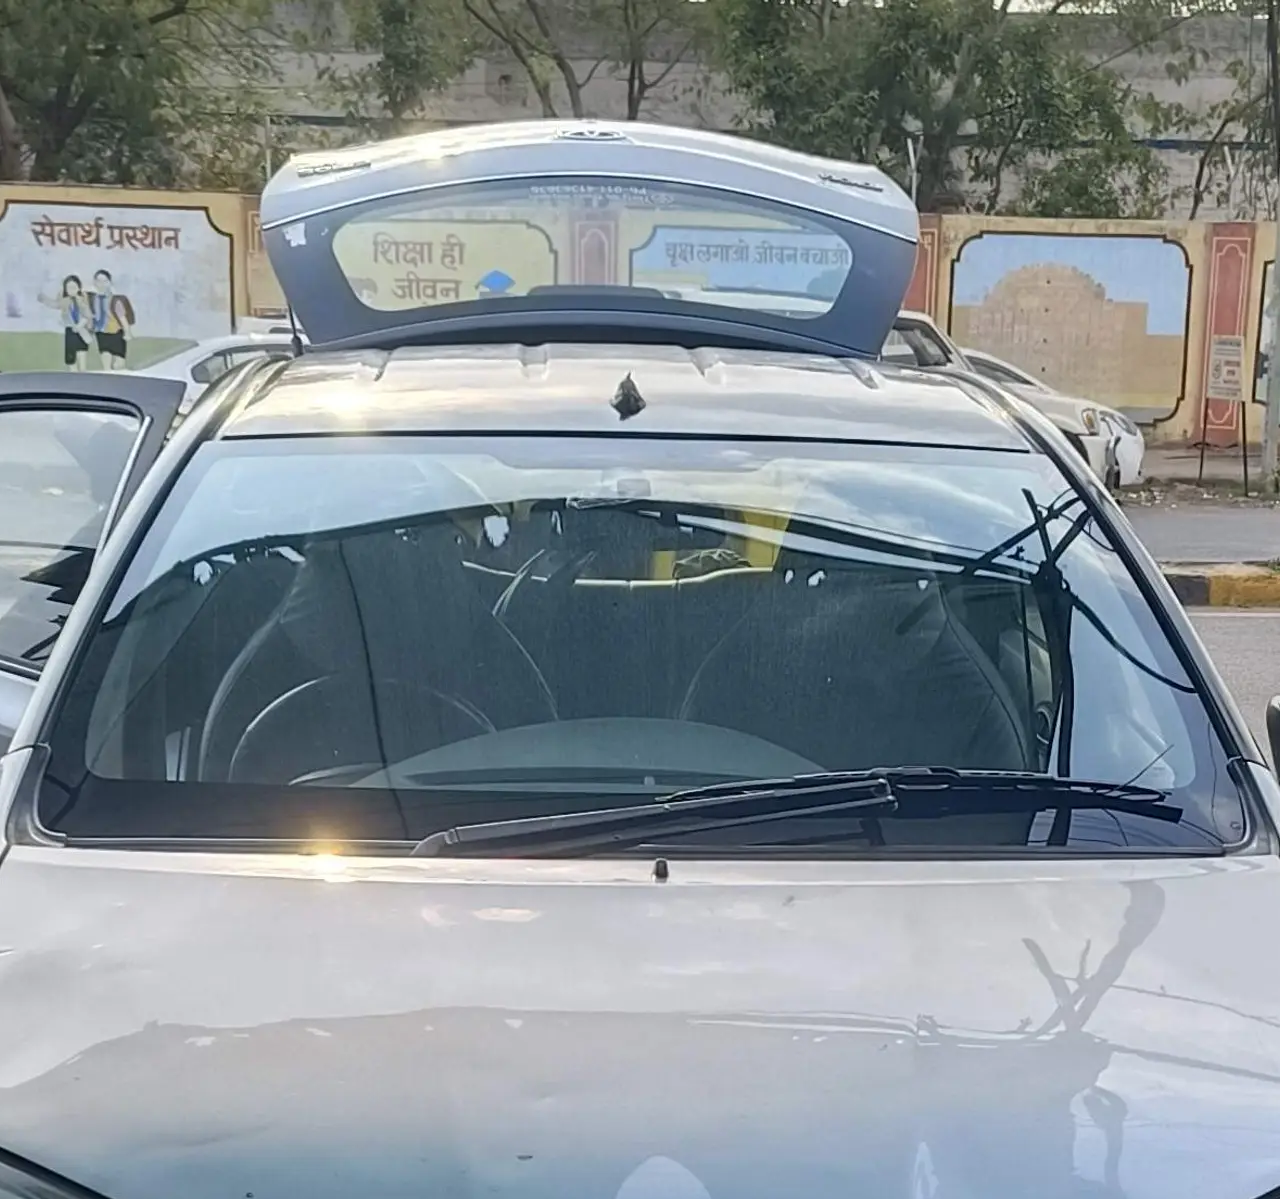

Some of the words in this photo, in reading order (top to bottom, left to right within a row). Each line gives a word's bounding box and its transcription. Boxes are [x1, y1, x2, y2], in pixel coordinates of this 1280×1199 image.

[31, 214, 104, 248] सेवार्थ
[106, 223, 181, 250] प्रस्थान
[373, 231, 433, 268] शिक्षा
[439, 233, 466, 271] ही
[391, 270, 462, 301] जीवन
